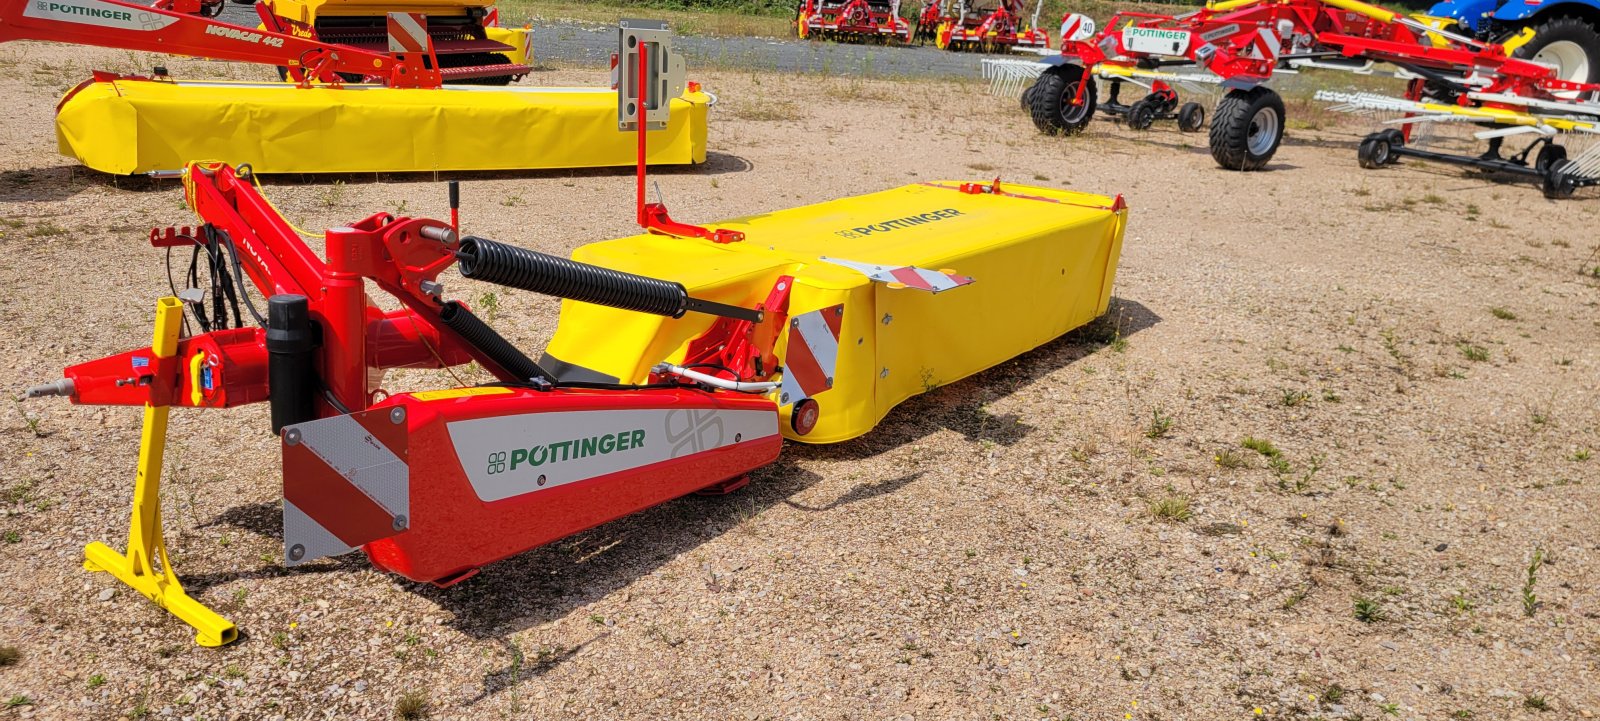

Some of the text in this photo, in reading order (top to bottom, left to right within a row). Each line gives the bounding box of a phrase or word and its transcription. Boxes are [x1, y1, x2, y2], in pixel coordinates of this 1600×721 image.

[205, 24, 285, 48] NOVACAT 442
[291, 24, 312, 39] Vredo
[1082, 22, 1093, 34] 40
[509, 429, 646, 471] PÖTTINGER
